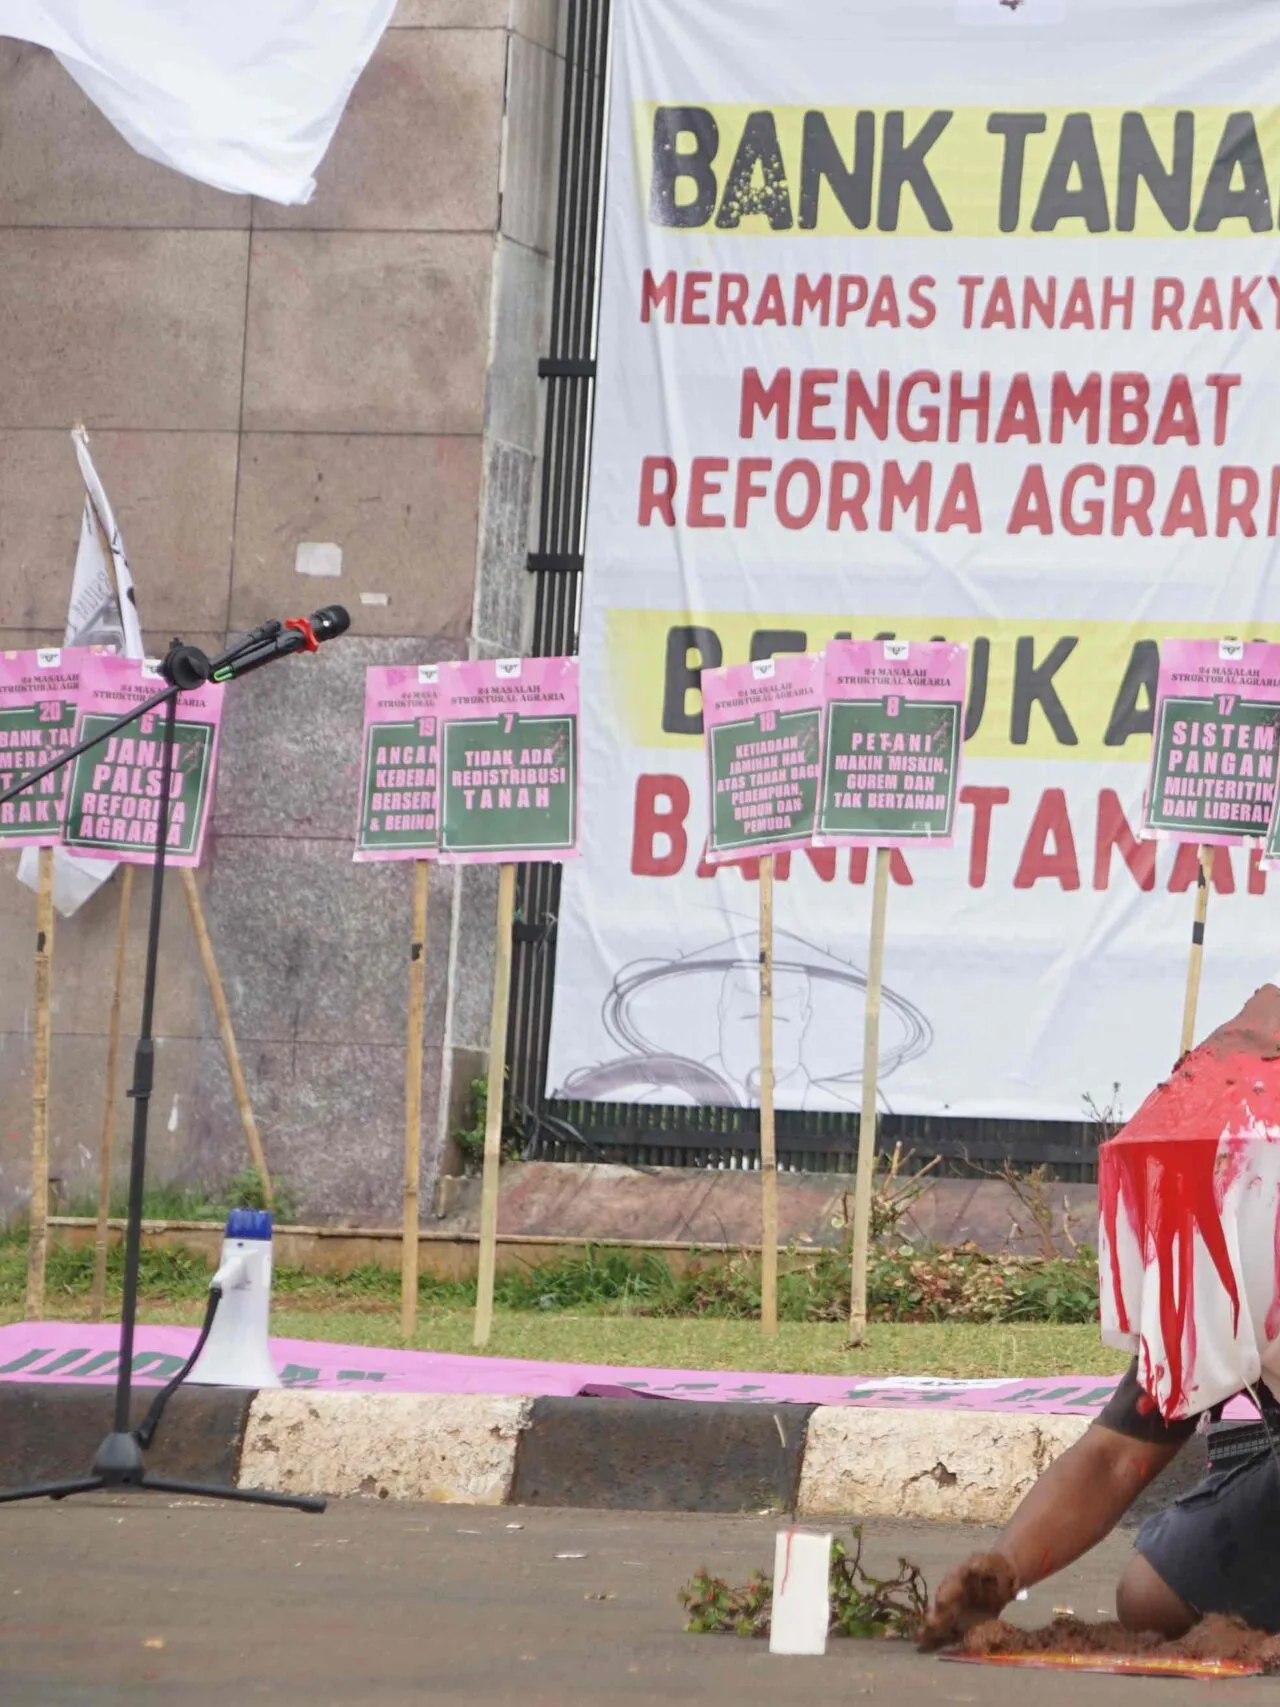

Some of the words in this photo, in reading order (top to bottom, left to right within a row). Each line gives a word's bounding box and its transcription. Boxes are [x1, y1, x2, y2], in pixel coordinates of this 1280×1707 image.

[649, 106, 953, 231] BANK
[640, 268, 936, 328] MERAMPAS
[957, 275, 1133, 330] TANAH
[739, 366, 1241, 446] MENGHAMBAT
[638, 456, 982, 533] REFORMA
[837, 676, 905, 686] STRUKTURAL
[907, 678, 952, 687] AGRARIA
[878, 668, 928, 677] MASALAH
[1171, 673, 1238, 684] STRUKTURAL
[1211, 668, 1260, 678] MASALAH
[451, 696, 517, 705] STRUKTURAL
[521, 693, 565, 703] AGRARIA
[490, 685, 541, 695] MASALAH
[715, 694, 774, 710] STRUKTURAL
[775, 687, 814, 701] AGRARIA
[748, 682, 793, 696] MASALAH
[1217, 695, 1236, 717] 17
[503, 714, 514, 734] 7
[0, 730, 42, 747] BANK
[851, 732, 933, 753] PETANI
[1172, 720, 1275, 750] SISTEM
[464, 750, 513, 767] TIDAK
[519, 748, 553, 765] ADA
[735, 736, 798, 759] KETIADAAN
[729, 755, 779, 776] JAMINAN
[782, 751, 806, 768] HAK
[835, 755, 883, 772] MAKIN
[888, 755, 949, 775] MISKIN,
[1168, 749, 1273, 778] PANGAN
[92, 764, 184, 799] PALSU
[376, 768, 436, 788] KEBEBA
[452, 767, 566, 787] REDISTRIBUSI
[717, 776, 746, 793] ATAS
[750, 768, 787, 788] TANAH
[846, 774, 898, 790] GUREM
[903, 775, 935, 791] DAN
[463, 788, 549, 810] TANAH
[734, 802, 774, 820] BURUH
[776, 798, 803, 814] DAN
[834, 792, 862, 809] TAK
[867, 792, 946, 811] BERTANAH
[1, 800, 65, 823] RAKY
[1162, 798, 1197, 818] DAN
[1203, 801, 1272, 823] LIBERAL
[80, 815, 181, 846] AGRARA
[743, 815, 792, 834] PEMUDA
